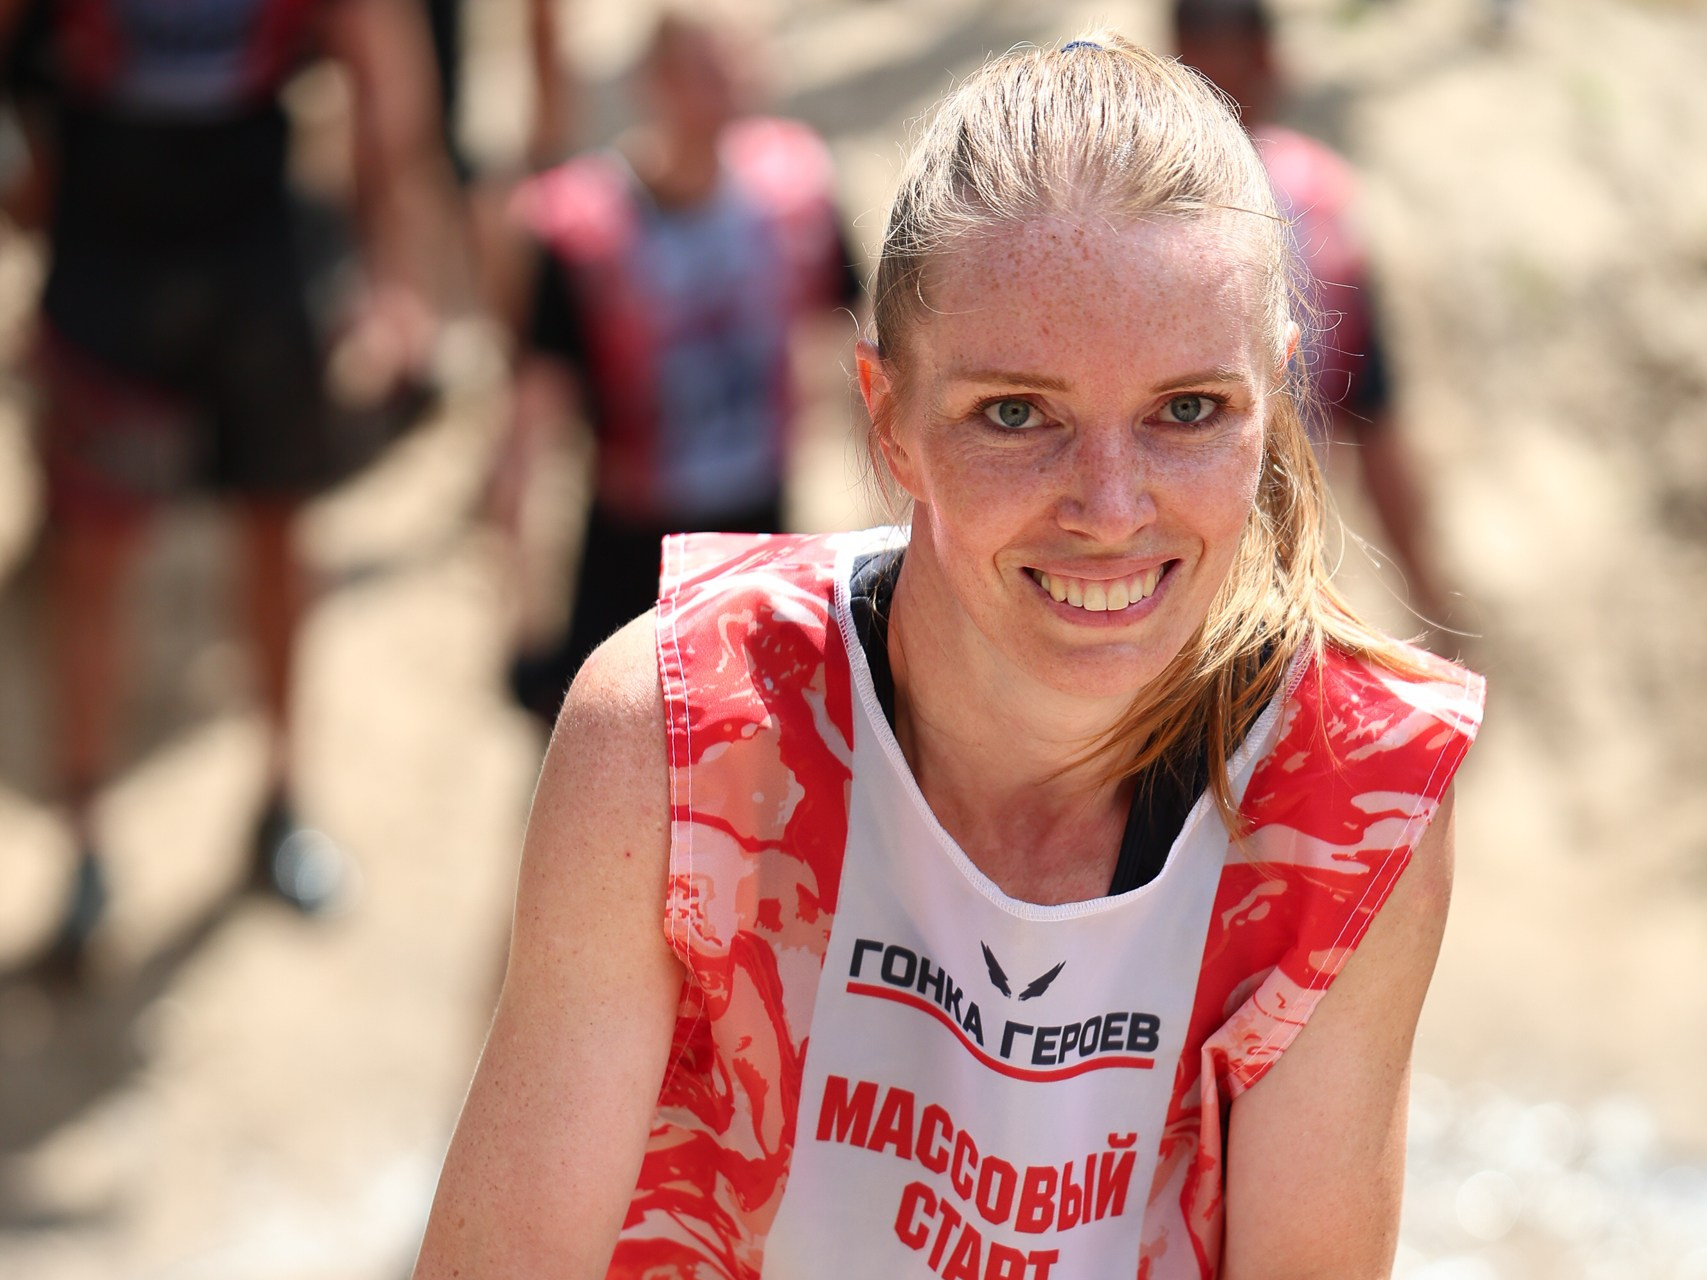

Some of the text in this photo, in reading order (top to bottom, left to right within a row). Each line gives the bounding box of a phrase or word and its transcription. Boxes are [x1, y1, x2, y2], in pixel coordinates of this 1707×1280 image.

[849, 938, 1160, 1065] ГОНКА ГЕРОЕВ
[816, 1075, 1137, 1234] МАССОВЫЙ
